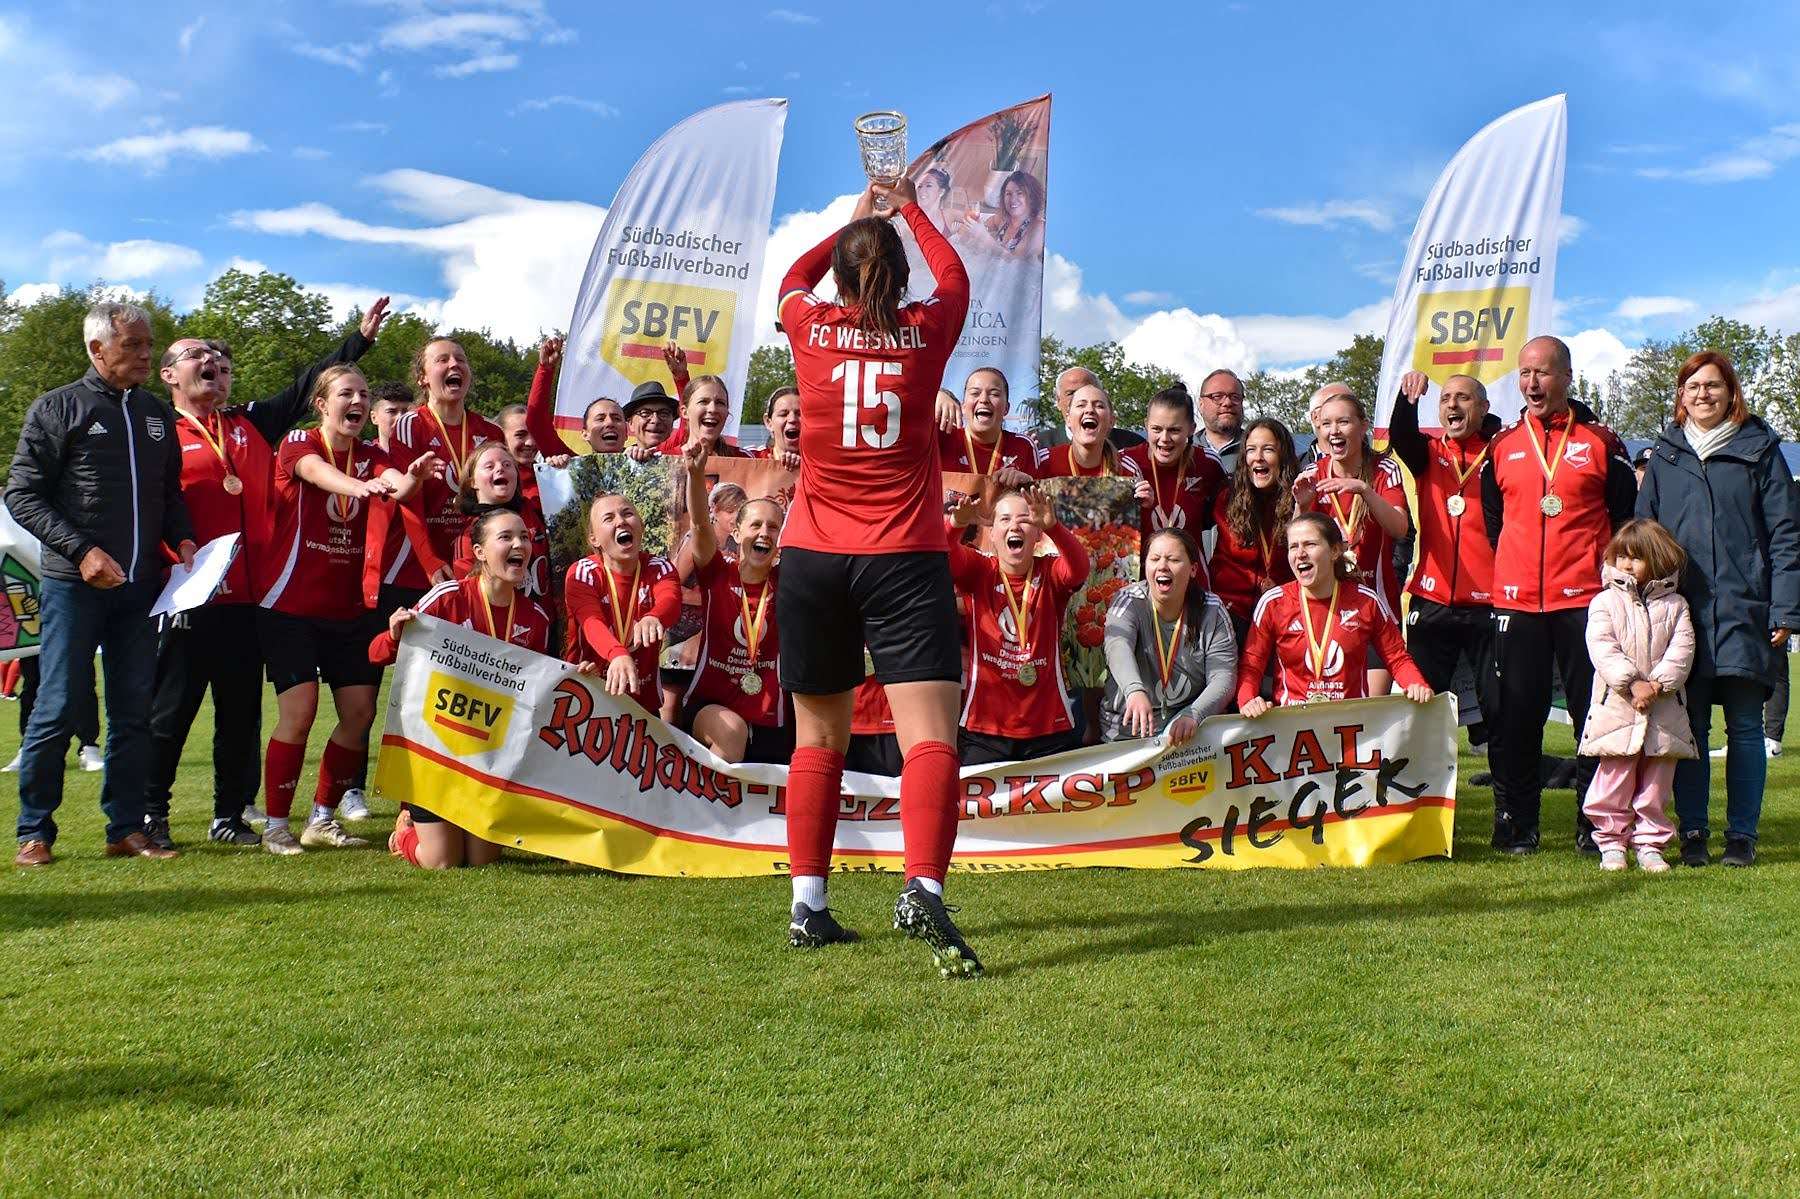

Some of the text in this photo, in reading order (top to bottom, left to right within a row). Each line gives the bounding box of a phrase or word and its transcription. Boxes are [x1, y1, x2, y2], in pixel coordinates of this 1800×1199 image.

[621, 225, 742, 255] Südbadischer
[1427, 234, 1532, 261] Südbadischer
[607, 248, 750, 280] Fußballverband
[1416, 256, 1541, 283] Fußballverband
[620, 299, 720, 344] SBFV
[808, 323, 832, 348] FC
[1429, 306, 1515, 346] SBFV
[831, 359, 903, 450] 15
[171, 613, 192, 629] AL
[430, 650, 526, 692] Fußballverband
[442, 638, 523, 675] Südbadischer
[435, 688, 502, 727] SBFV
[1224, 723, 1382, 790] KAL
[1169, 771, 1209, 788] SBFV
[1180, 757, 1430, 864] SIEGER
